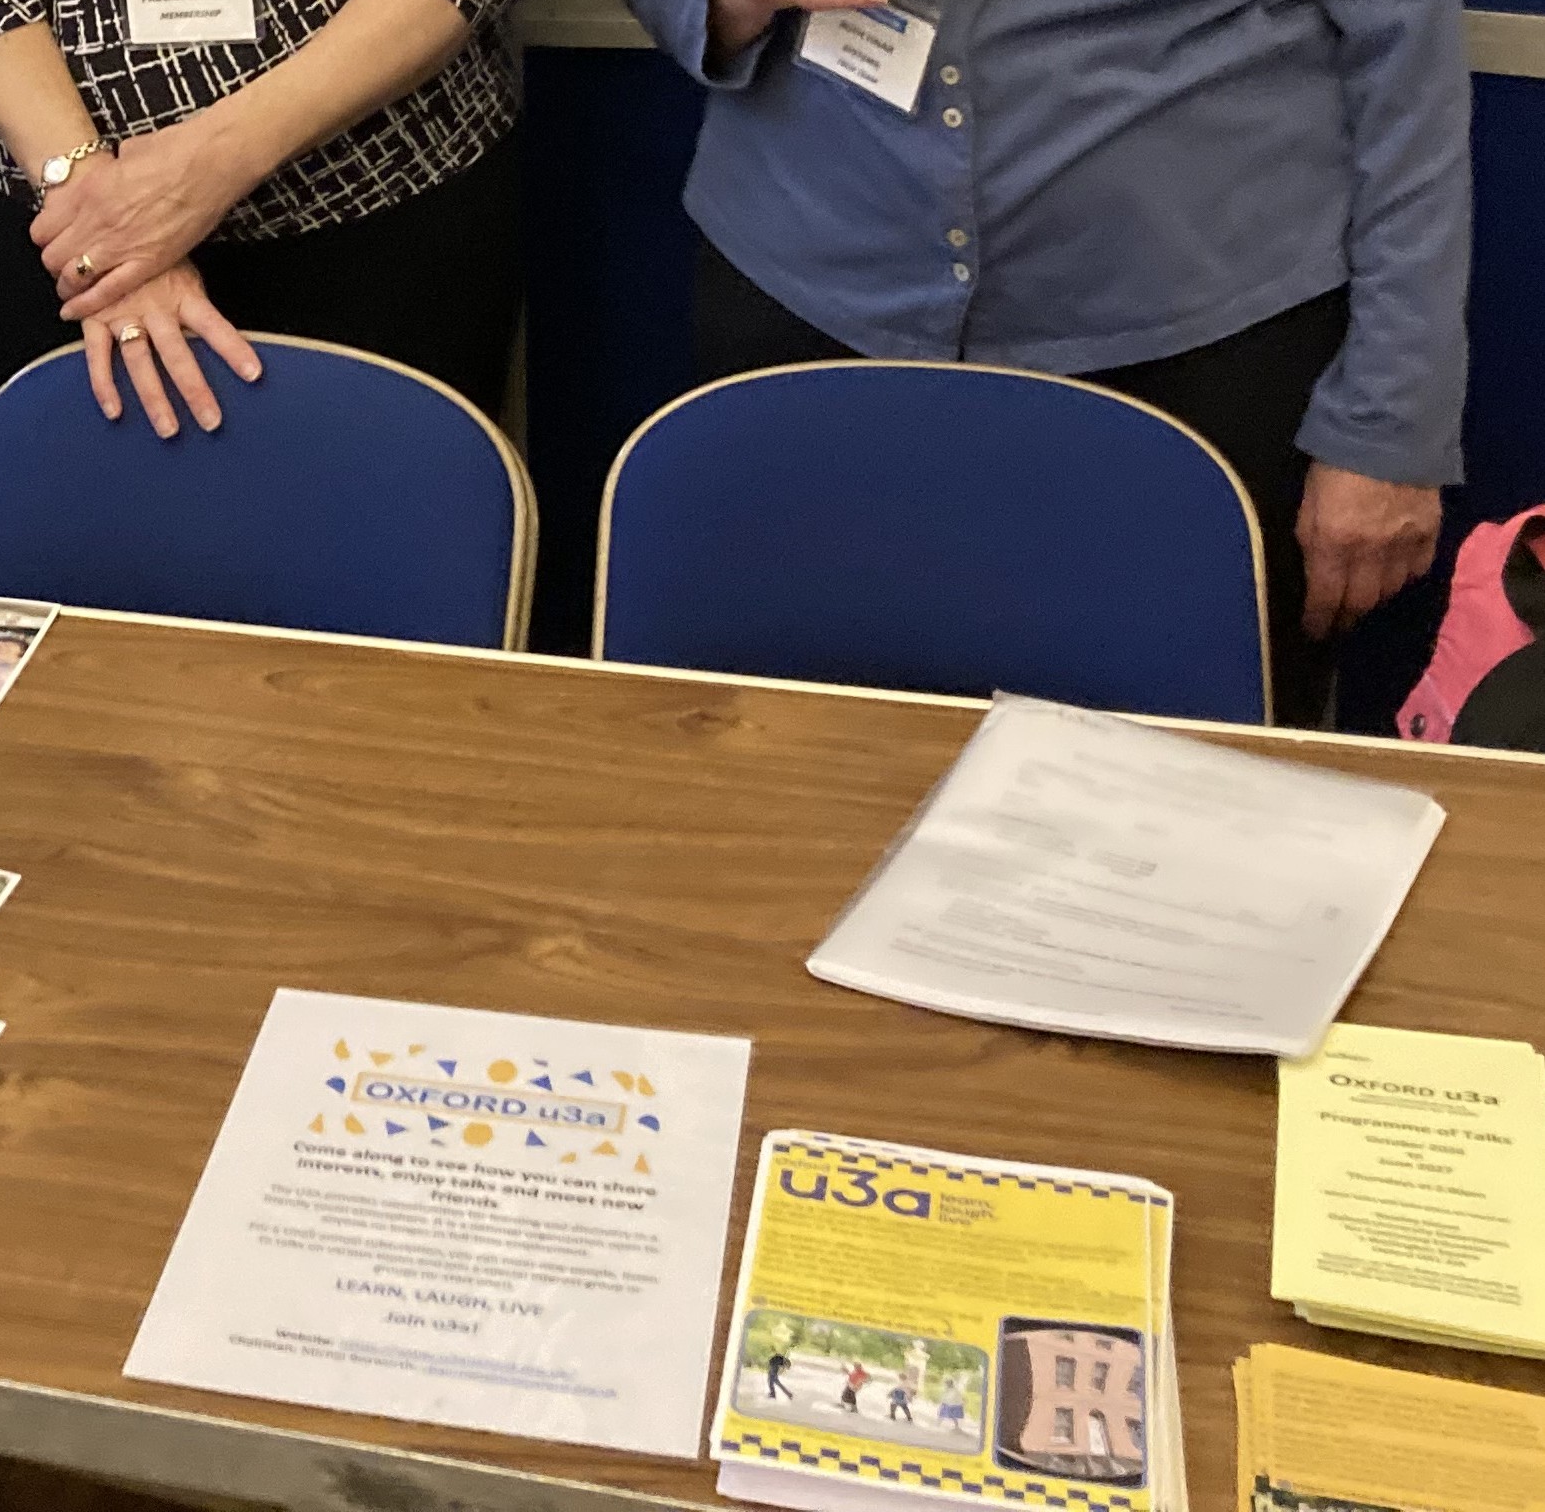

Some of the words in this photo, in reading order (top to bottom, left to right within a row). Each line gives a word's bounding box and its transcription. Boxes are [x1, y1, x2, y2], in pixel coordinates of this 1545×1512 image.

[160, 8, 222, 21] MEMBERSHIP
[365, 1081, 527, 1116] OXFORD
[539, 1104, 606, 1127] u3a
[1444, 1090, 1500, 1107] u3a
[1319, 1111, 1431, 1135] Programme
[1436, 1128, 1460, 1138] of
[1462, 1129, 1513, 1146] Talks
[293, 1140, 347, 1157] Come
[352, 1147, 405, 1168] along
[410, 1155, 430, 1168] to
[435, 1159, 467, 1171] see
[474, 1163, 515, 1178] how
[521, 1171, 557, 1187] you
[562, 1176, 597, 1189] can
[604, 1180, 657, 1197] share
[392, 1170, 447, 1188] enjoy
[451, 1173, 497, 1192] talks
[502, 1184, 540, 1199] and
[544, 1190, 596, 1206] meet
[603, 1198, 645, 1211] new
[430, 1189, 499, 1209] friends
[779, 1167, 931, 1219] u3a
[335, 1277, 406, 1300] LEARN,
[415, 1290, 492, 1311] LAUGH,
[499, 1300, 544, 1317] LIVE
[384, 1311, 426, 1329] Join
